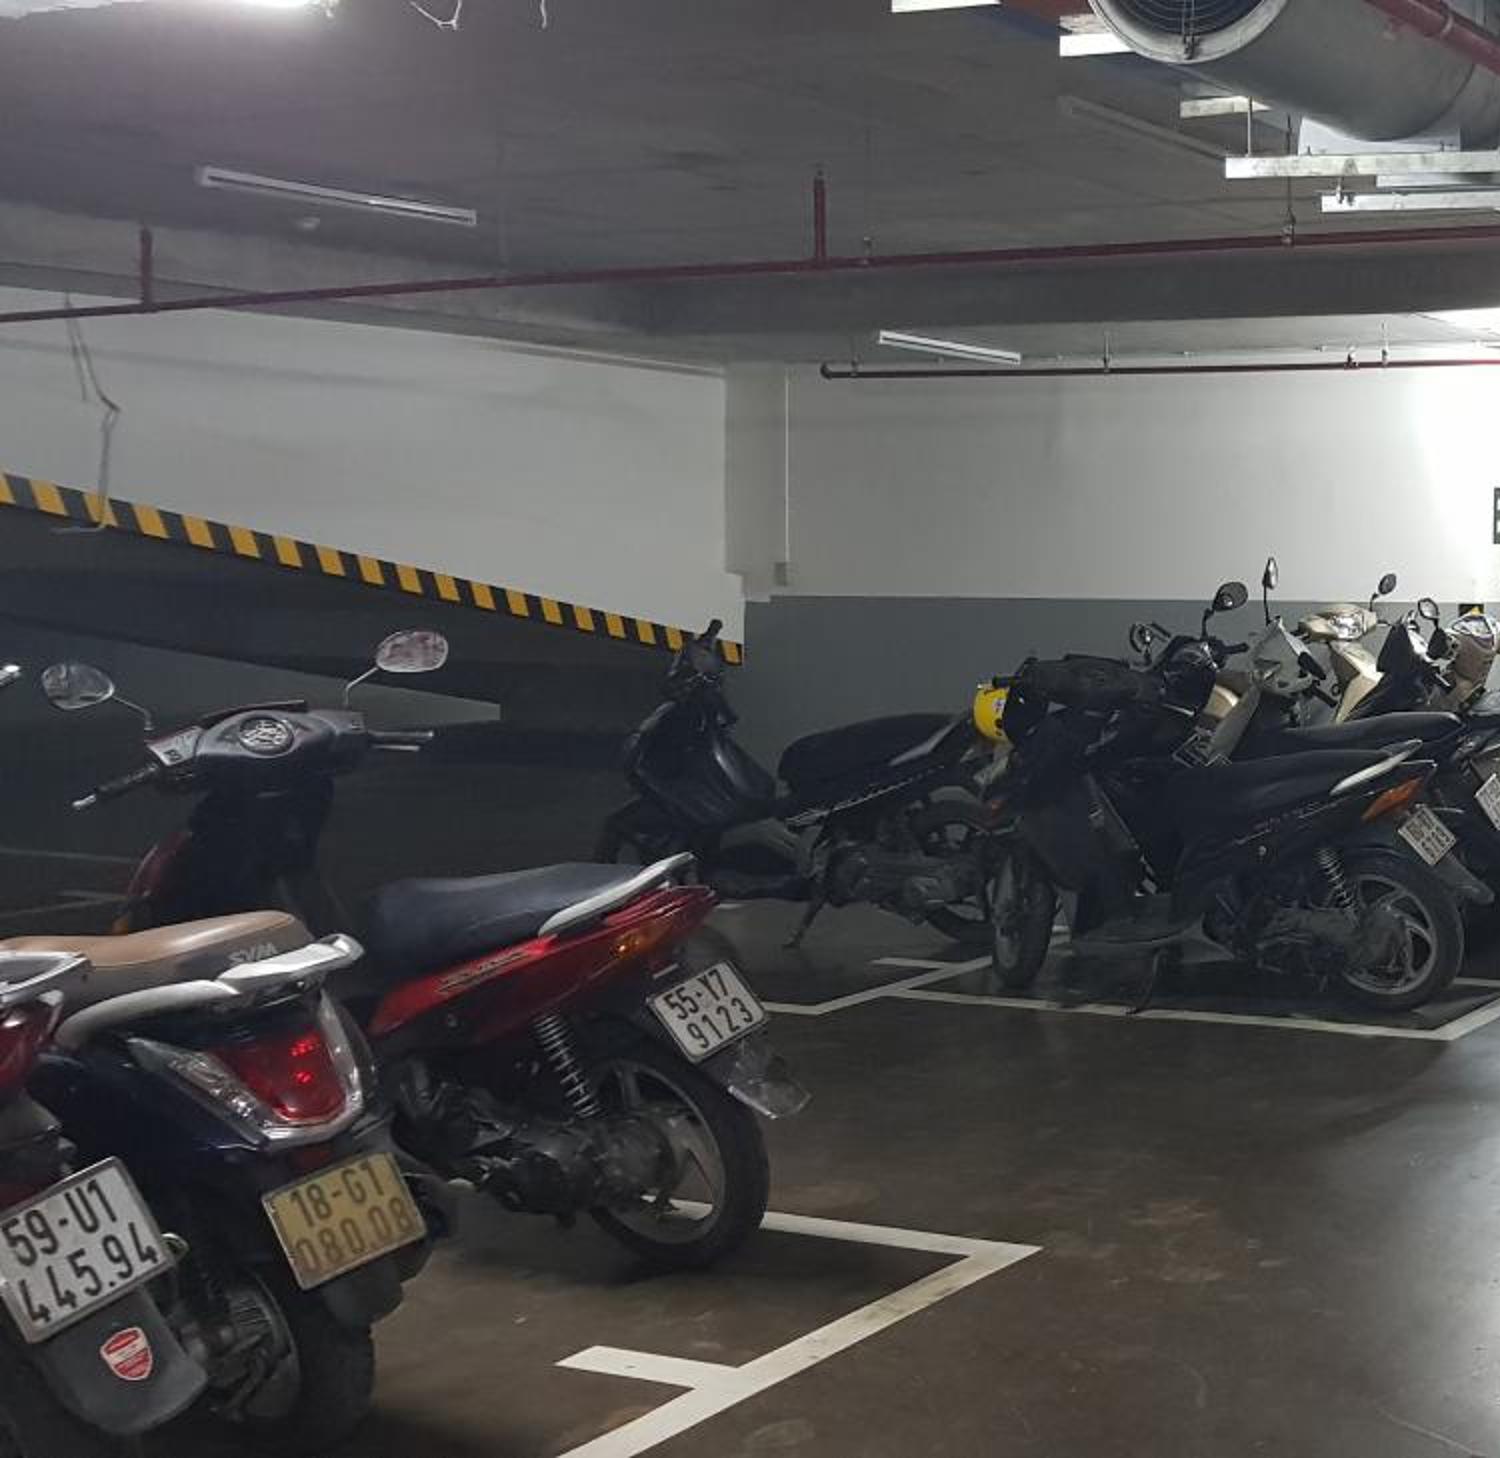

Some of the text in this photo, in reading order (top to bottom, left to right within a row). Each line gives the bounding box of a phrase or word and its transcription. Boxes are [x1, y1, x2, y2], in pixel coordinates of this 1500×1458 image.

[663, 968, 728, 1020] 55-Y7
[687, 997, 753, 1049] 9123
[0, 1179, 117, 1267] 59-U1
[290, 1161, 385, 1228] 18-G1
[19, 1221, 159, 1324] 445.94
